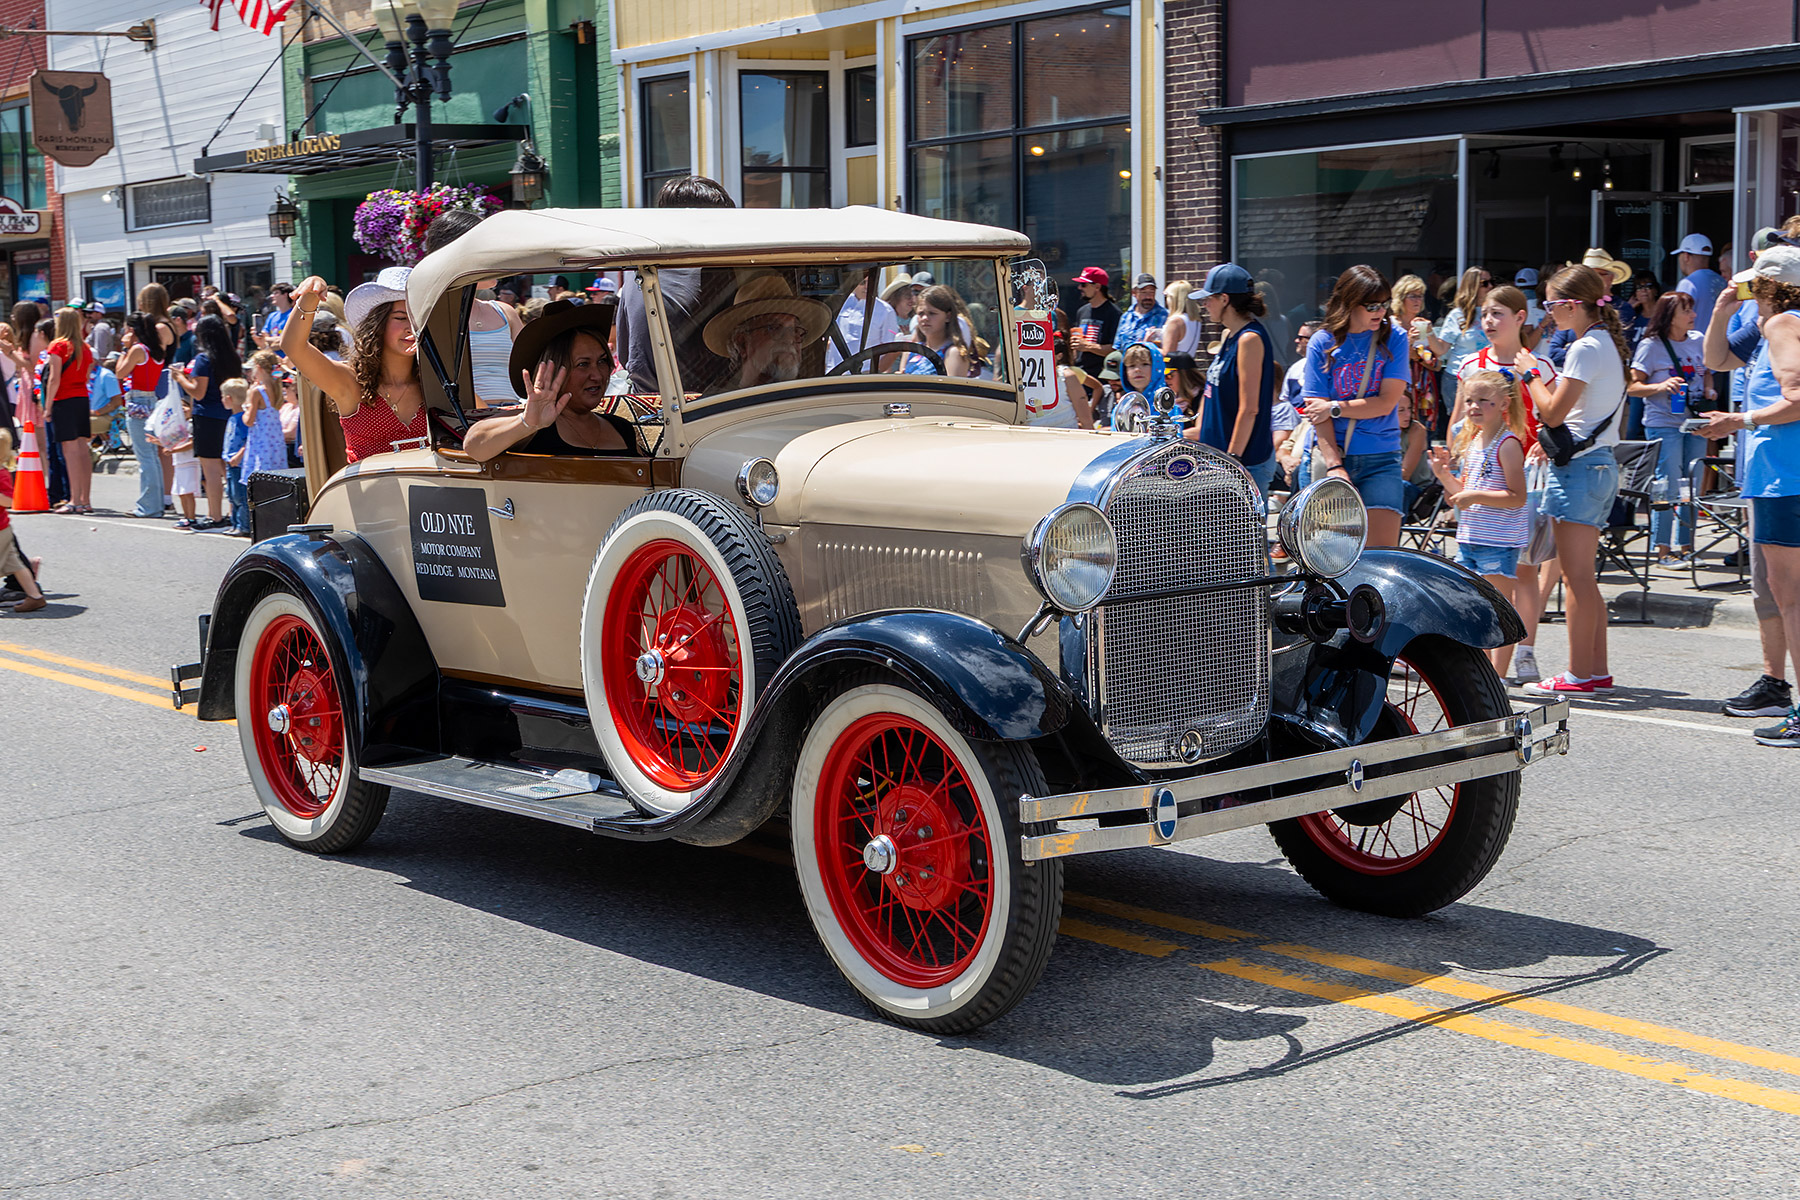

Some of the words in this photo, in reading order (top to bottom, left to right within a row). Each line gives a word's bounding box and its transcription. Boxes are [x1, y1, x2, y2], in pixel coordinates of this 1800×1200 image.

[38, 135, 63, 144] PARIS
[66, 135, 111, 144] MONTANA
[246, 143, 286, 163] FOSTER
[286, 142, 295, 157] &
[8, 215, 36, 227] PEAK
[1170, 463, 1189, 473] Ford
[420, 511, 446, 534] OLD
[447, 513, 476, 536] NYE
[420, 542, 446, 556] MOTOR
[446, 544, 482, 558] COMPANY
[415, 562, 430, 575] RED
[429, 563, 455, 577] LODGE
[457, 566, 497, 580] MONTANA
